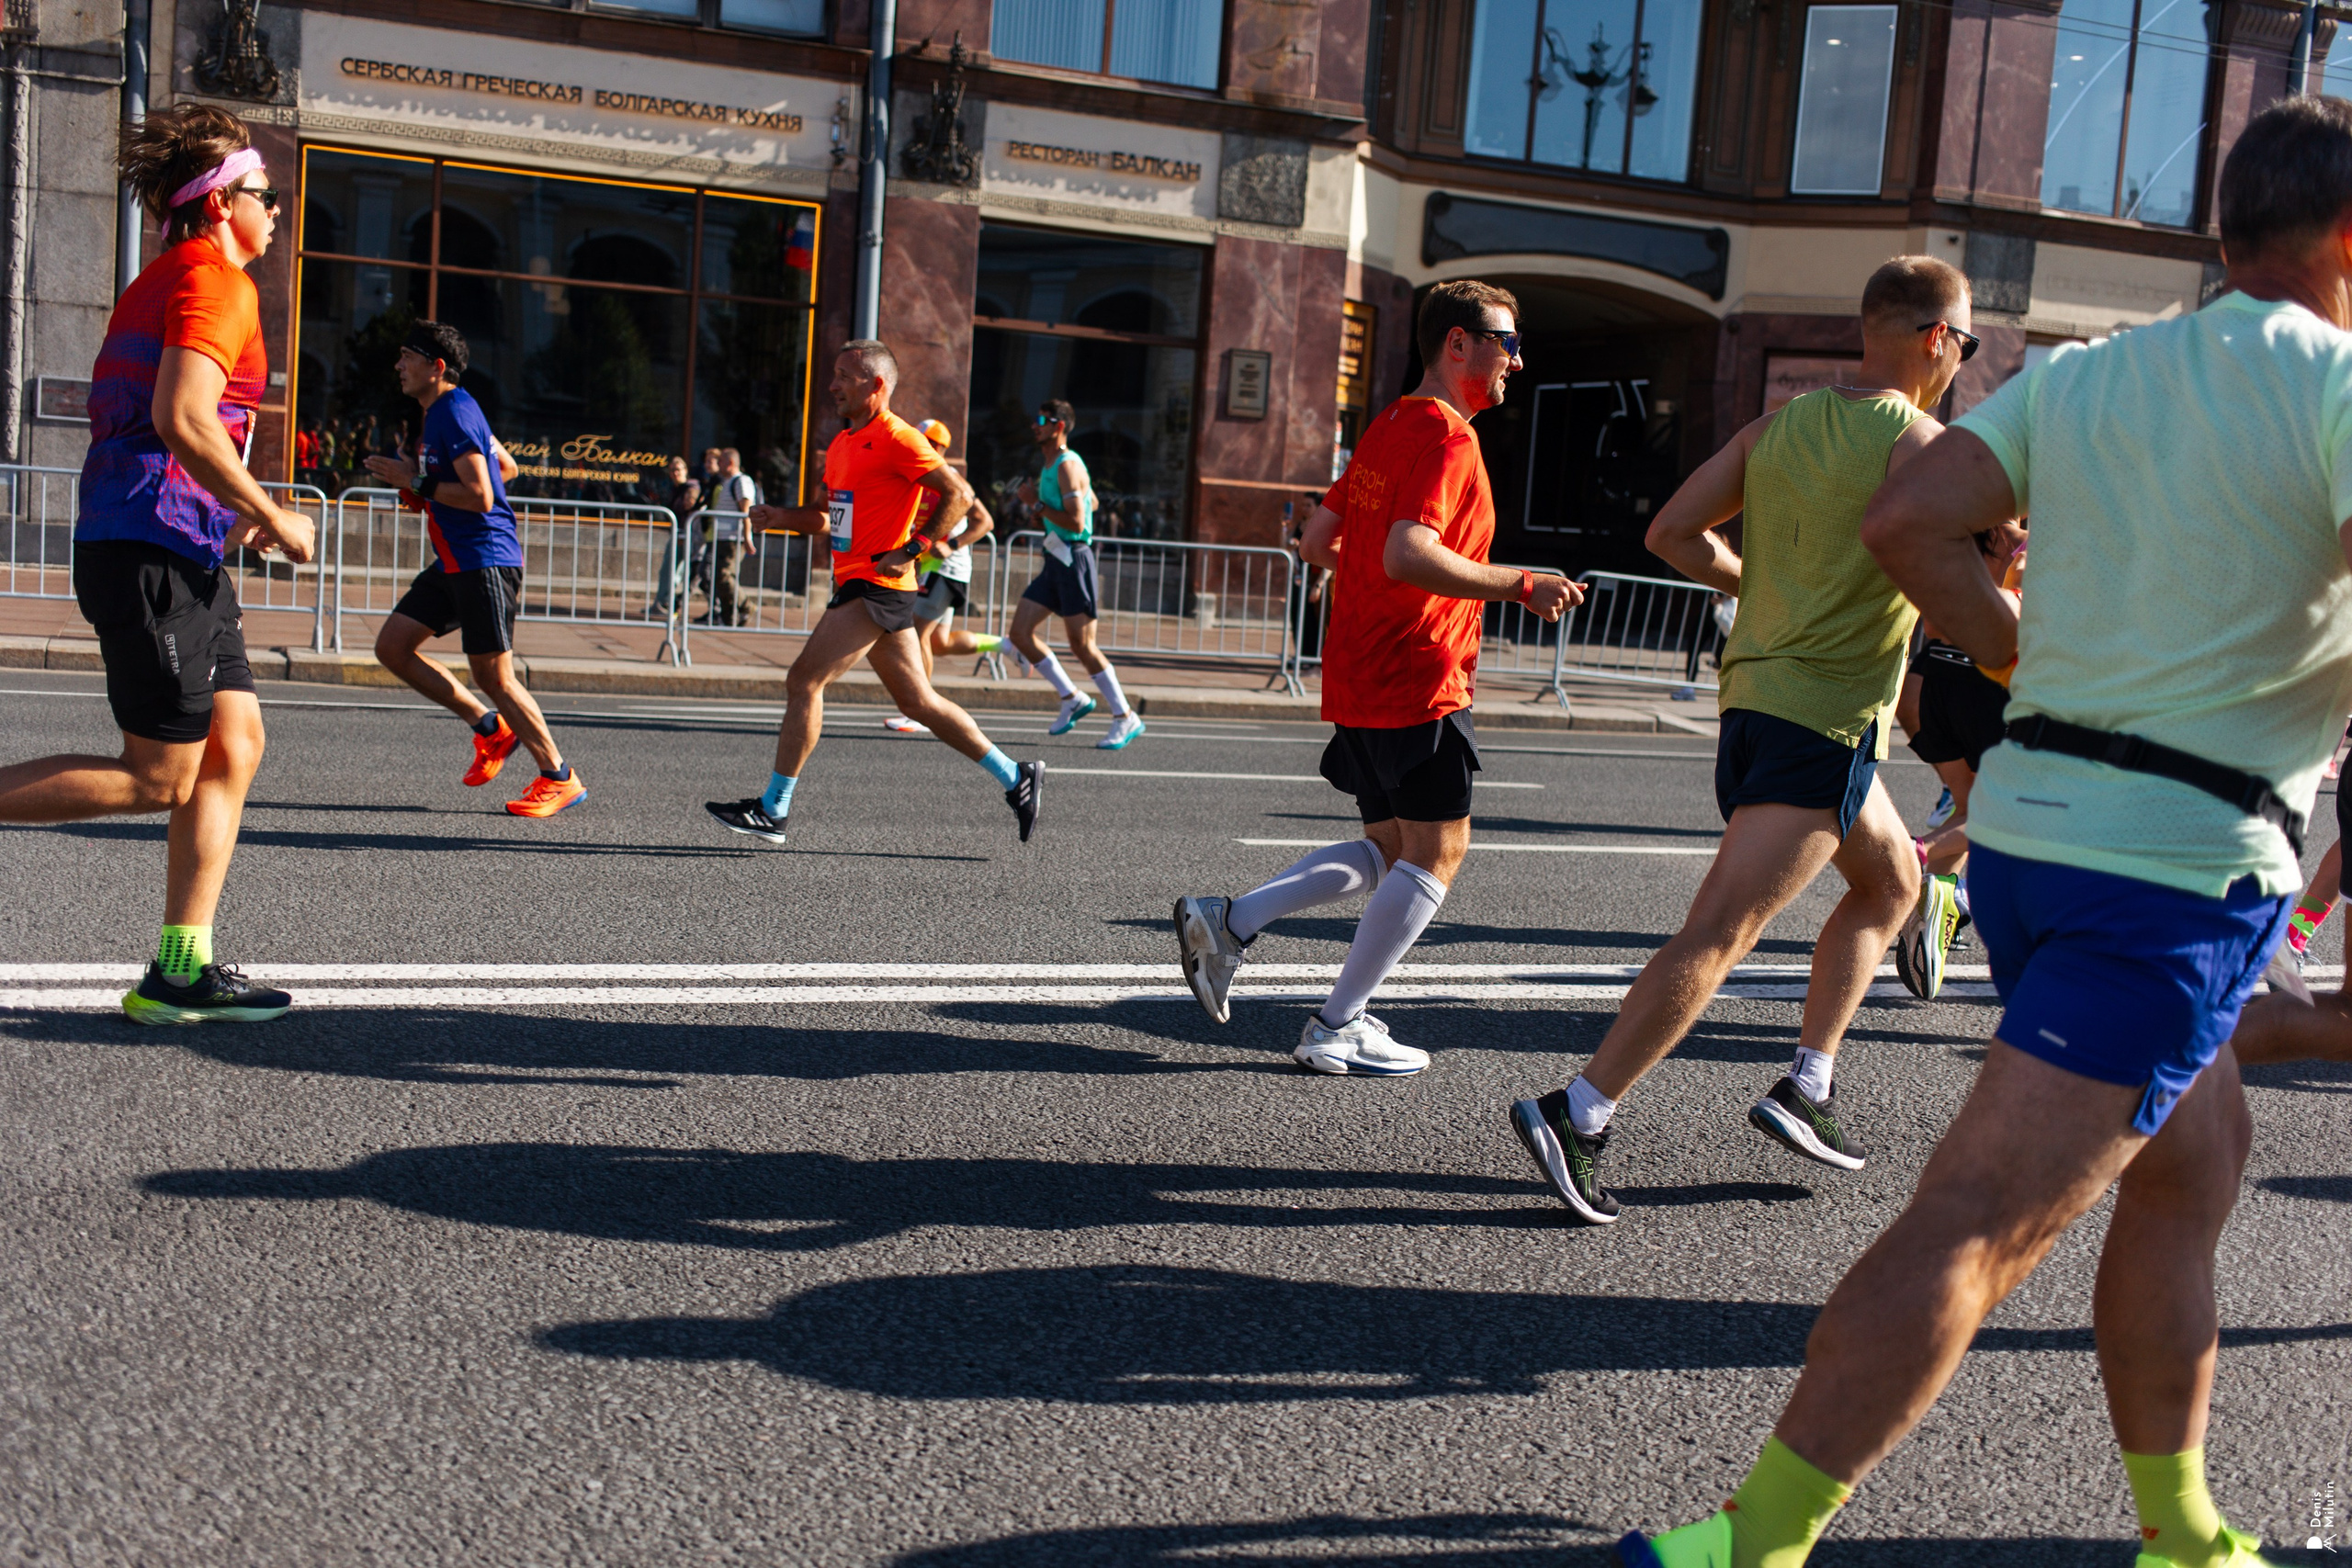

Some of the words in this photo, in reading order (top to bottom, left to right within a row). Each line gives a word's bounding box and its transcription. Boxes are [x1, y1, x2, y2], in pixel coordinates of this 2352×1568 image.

[340, 57, 453, 88] СЕРБСКАЯ
[462, 73, 582, 103] ГРЕЧЕСКАЯ
[594, 89, 727, 121] БОЛГАРСКАЯ
[737, 107, 803, 131] КУХНЯ
[1007, 141, 1101, 167] РЕСТОРАН
[1110, 151, 1202, 181] БАЛКАН
[560, 434, 669, 468] Балкан
